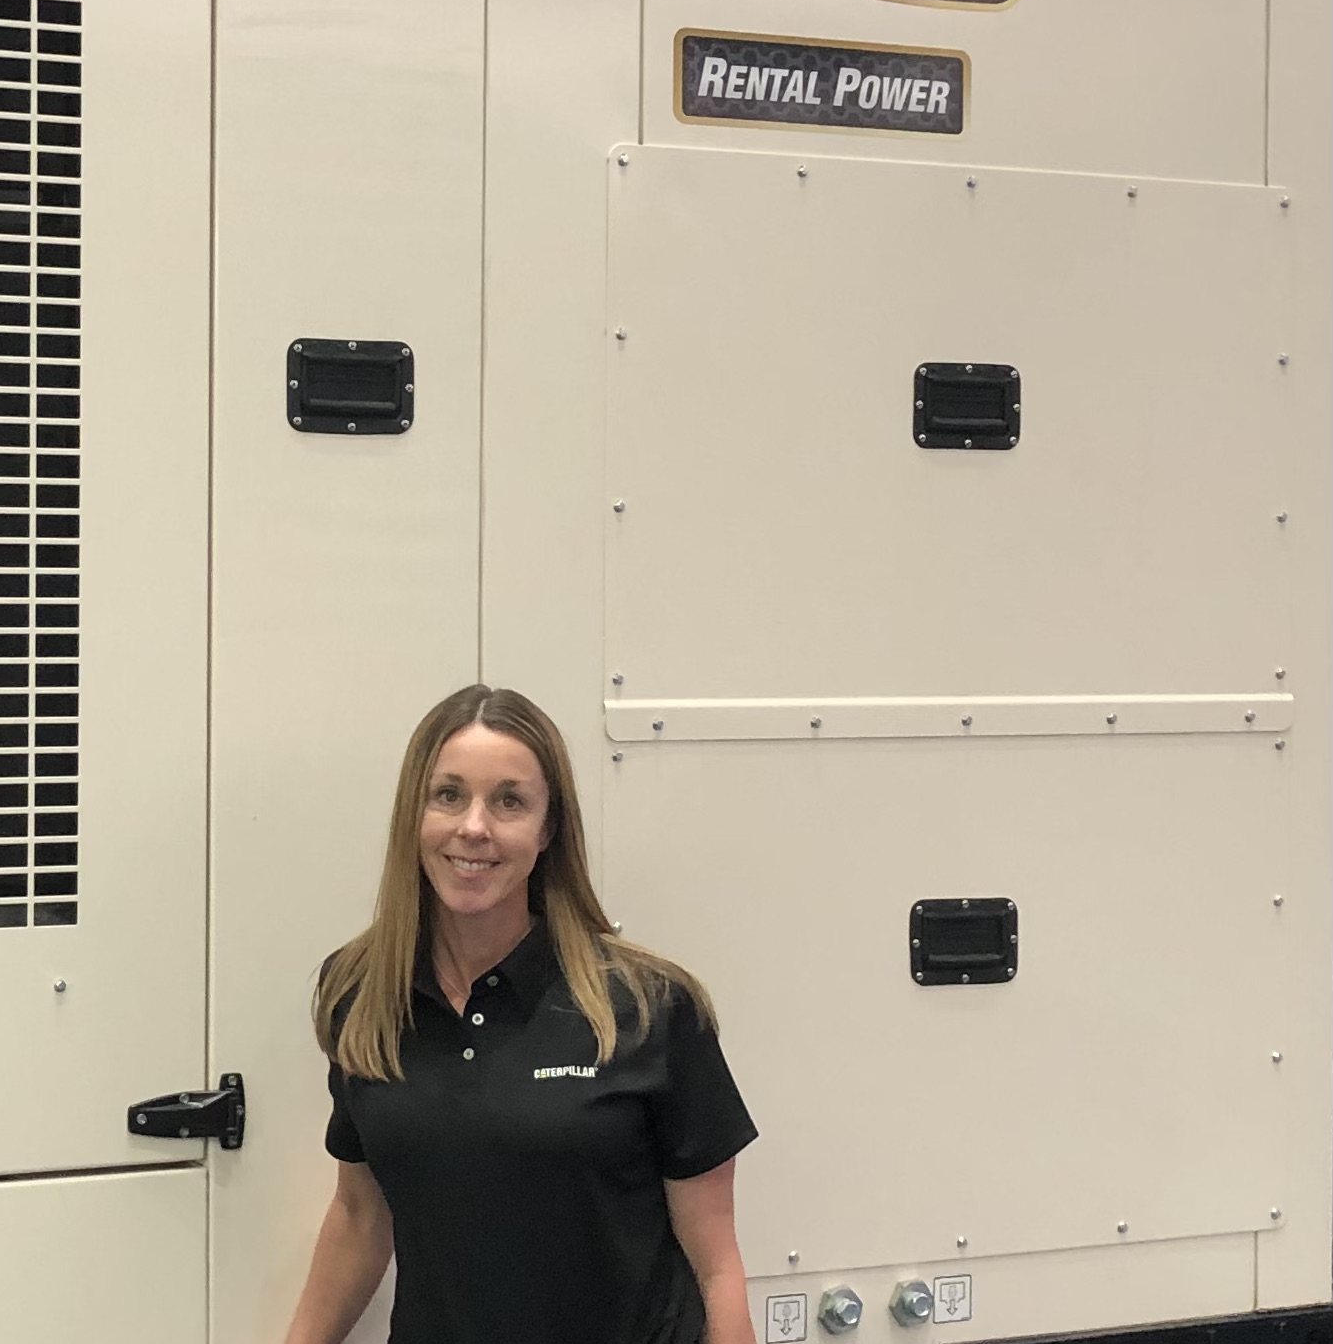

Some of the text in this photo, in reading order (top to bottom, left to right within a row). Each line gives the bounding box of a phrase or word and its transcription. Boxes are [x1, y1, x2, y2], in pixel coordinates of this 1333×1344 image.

[697, 56, 951, 114] RENTAL POWER
[533, 1065, 597, 1080] CATERPILLAR
